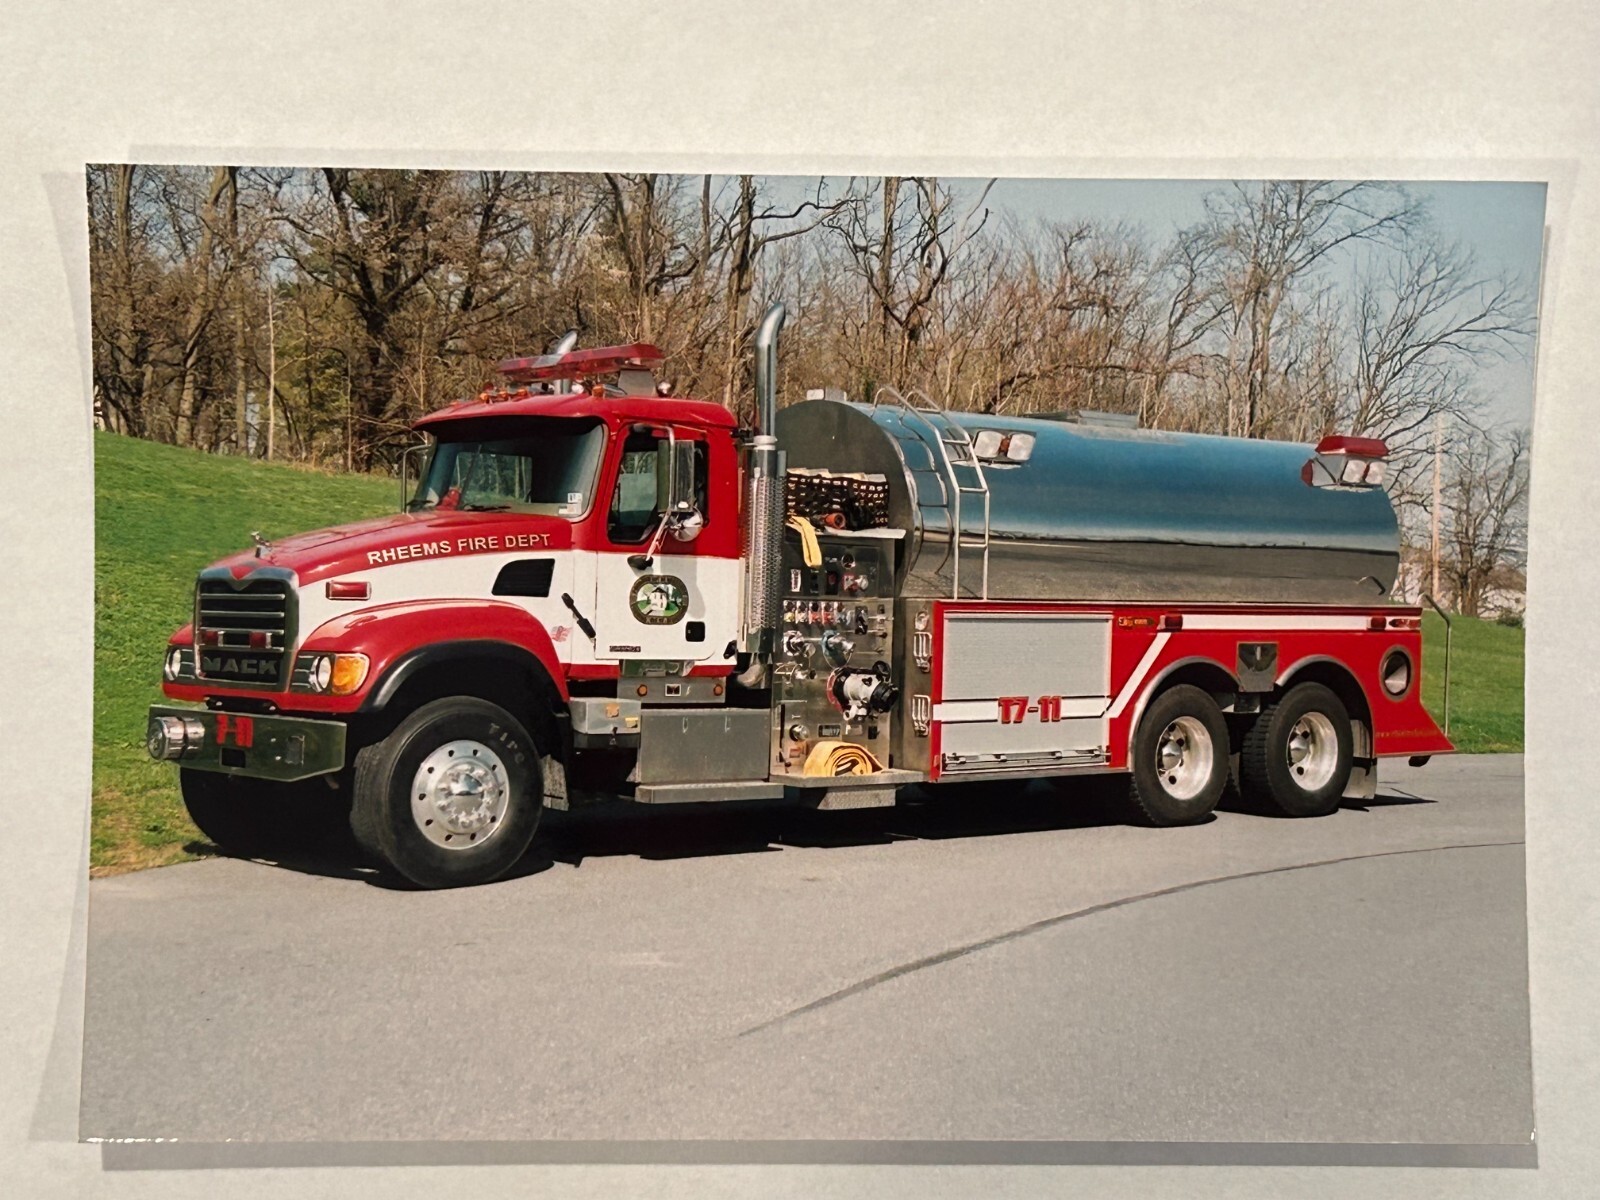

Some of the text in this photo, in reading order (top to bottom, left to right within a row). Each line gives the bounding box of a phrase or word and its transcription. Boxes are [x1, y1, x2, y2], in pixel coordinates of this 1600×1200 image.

[366, 540, 451, 565] RHEEMS
[457, 536, 499, 551] FIRE
[203, 656, 278, 675] MACK
